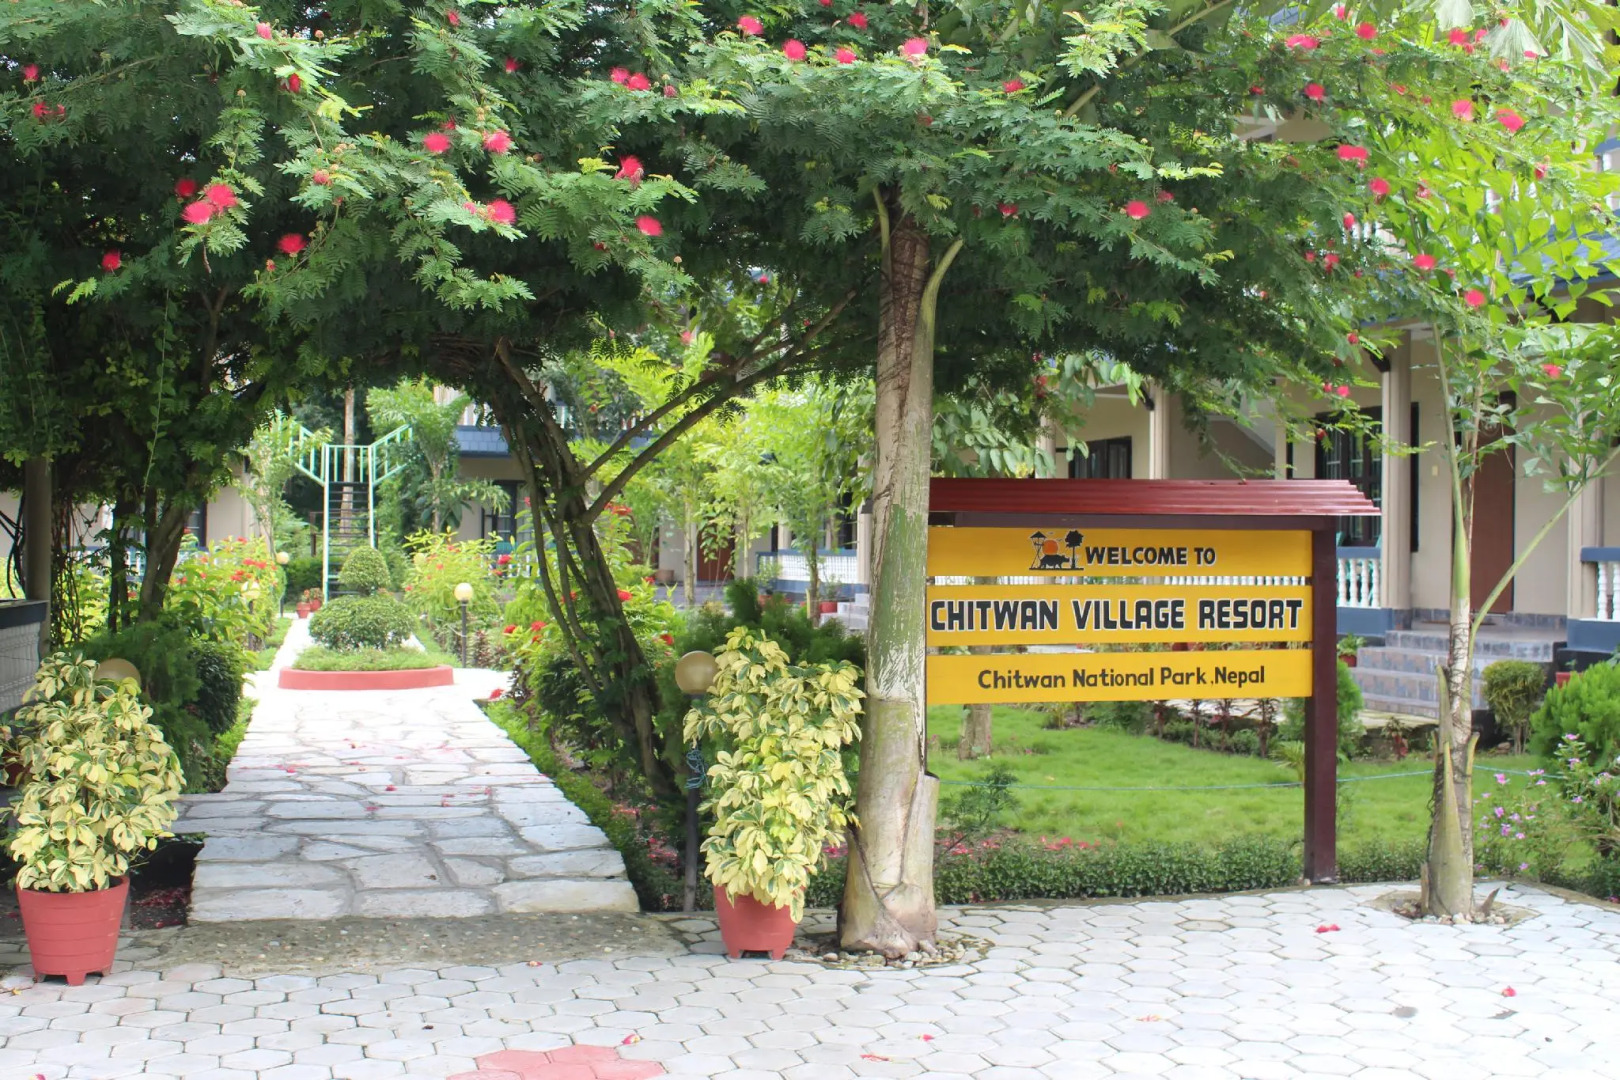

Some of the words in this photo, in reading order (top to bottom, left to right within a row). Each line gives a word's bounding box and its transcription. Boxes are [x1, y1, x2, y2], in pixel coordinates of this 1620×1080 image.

[1084, 546, 1188, 565] WELCOME
[1193, 546, 1216, 565] TO
[931, 600, 1059, 631] CHITWAN
[1072, 599, 1185, 630] VILLAGE
[1199, 599, 1303, 629] RESORT
[978, 669, 1066, 689] Chitwan
[1073, 667, 1154, 687] National
